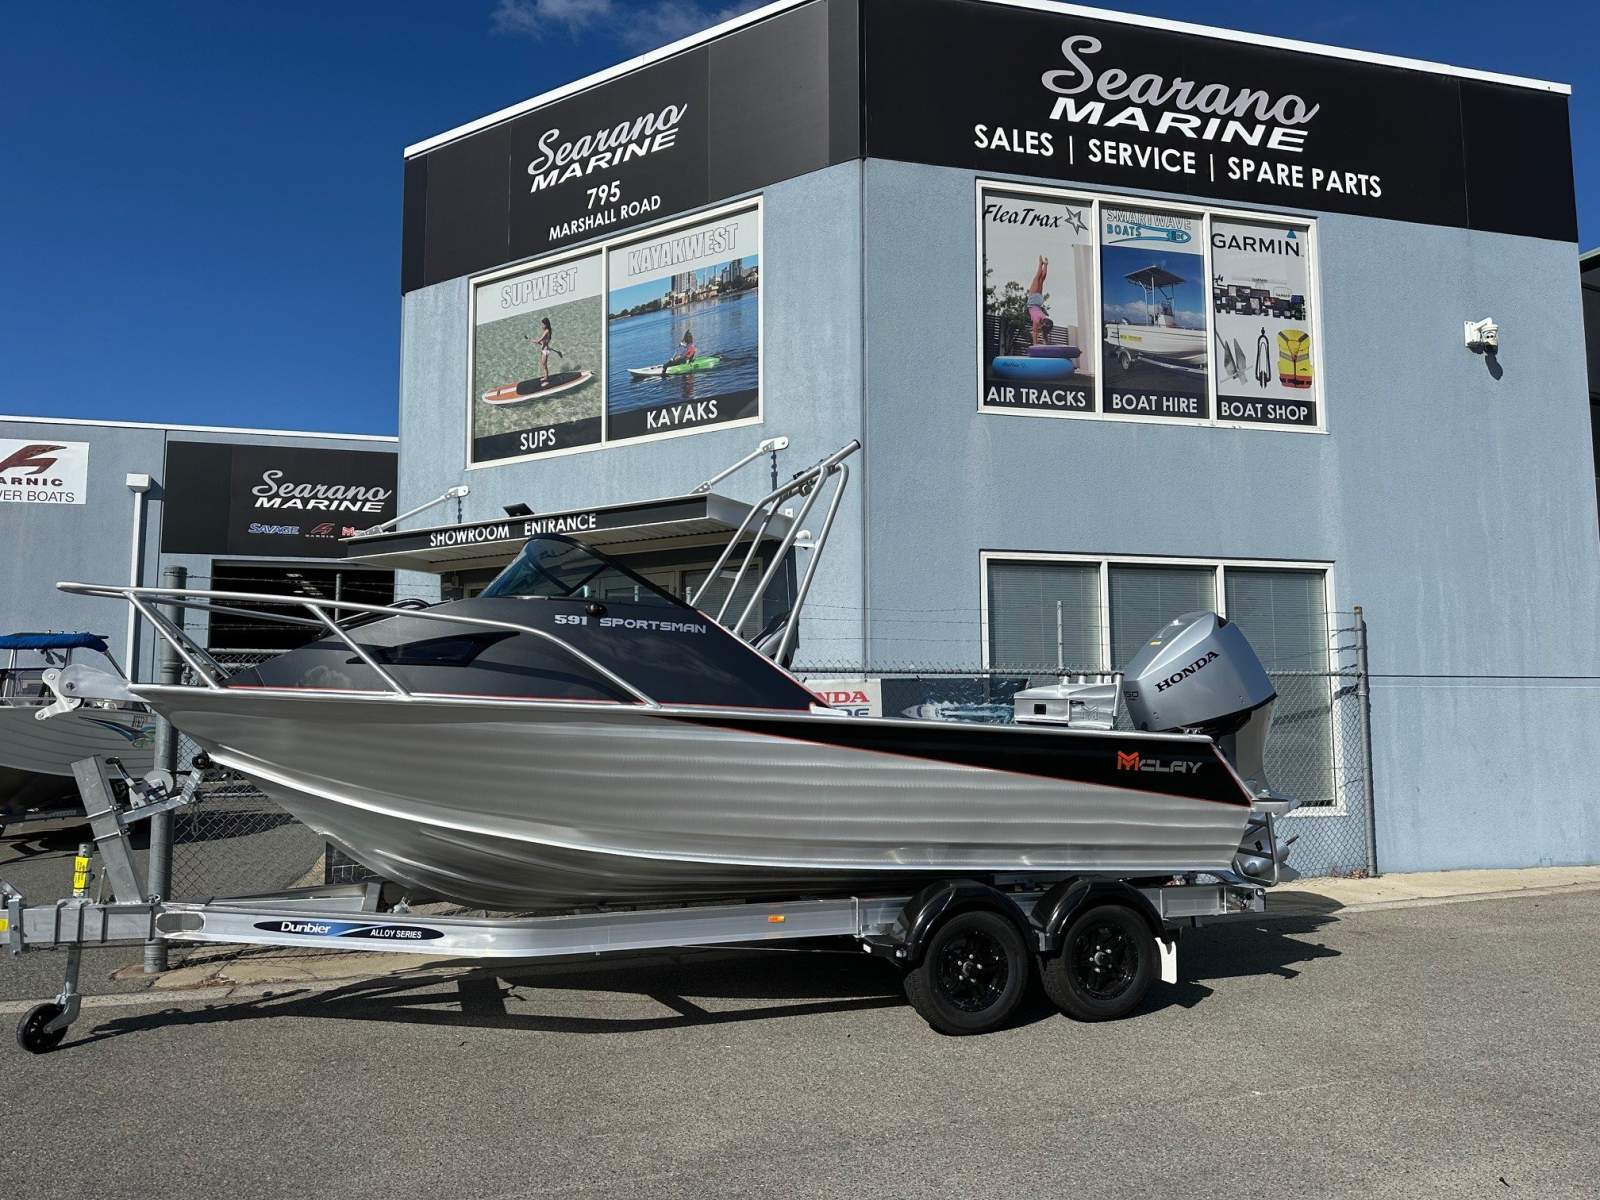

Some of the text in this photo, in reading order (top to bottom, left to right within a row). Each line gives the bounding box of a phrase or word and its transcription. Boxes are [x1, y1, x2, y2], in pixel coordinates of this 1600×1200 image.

[1041, 34, 1320, 126] Searano
[527, 103, 688, 175] Searano
[1049, 97, 1309, 153] MARINE
[530, 128, 679, 193] MARINE
[974, 124, 1382, 198] SALES SERVICE SPARE PARTS
[586, 180, 621, 209] 795
[549, 195, 661, 241] MARSHALL ROAD
[983, 204, 1063, 228] FleaTrax
[1106, 224, 1142, 238] BOATS
[1211, 233, 1300, 257] GARMIN
[628, 223, 738, 276] KAYAKWEST
[501, 267, 577, 309] SUPWEST
[986, 386, 1086, 408] AIR TRACKS
[1112, 394, 1198, 413] BOAT HIRE
[1221, 401, 1308, 421] BOAT SHOP
[646, 400, 718, 429] KAYAKS
[520, 428, 556, 450] SUPS
[27, 490, 75, 503] BOATS
[251, 469, 393, 501] Searano
[254, 496, 385, 513] MARINE
[430, 513, 597, 547] SHOWROOM ENTRANCE
[554, 614, 707, 634] 591 SPORTSMAN
[1154, 651, 1220, 693] HONDA
[280, 921, 332, 935] Dunbier
[370, 928, 422, 939] ALLOY SERIES
